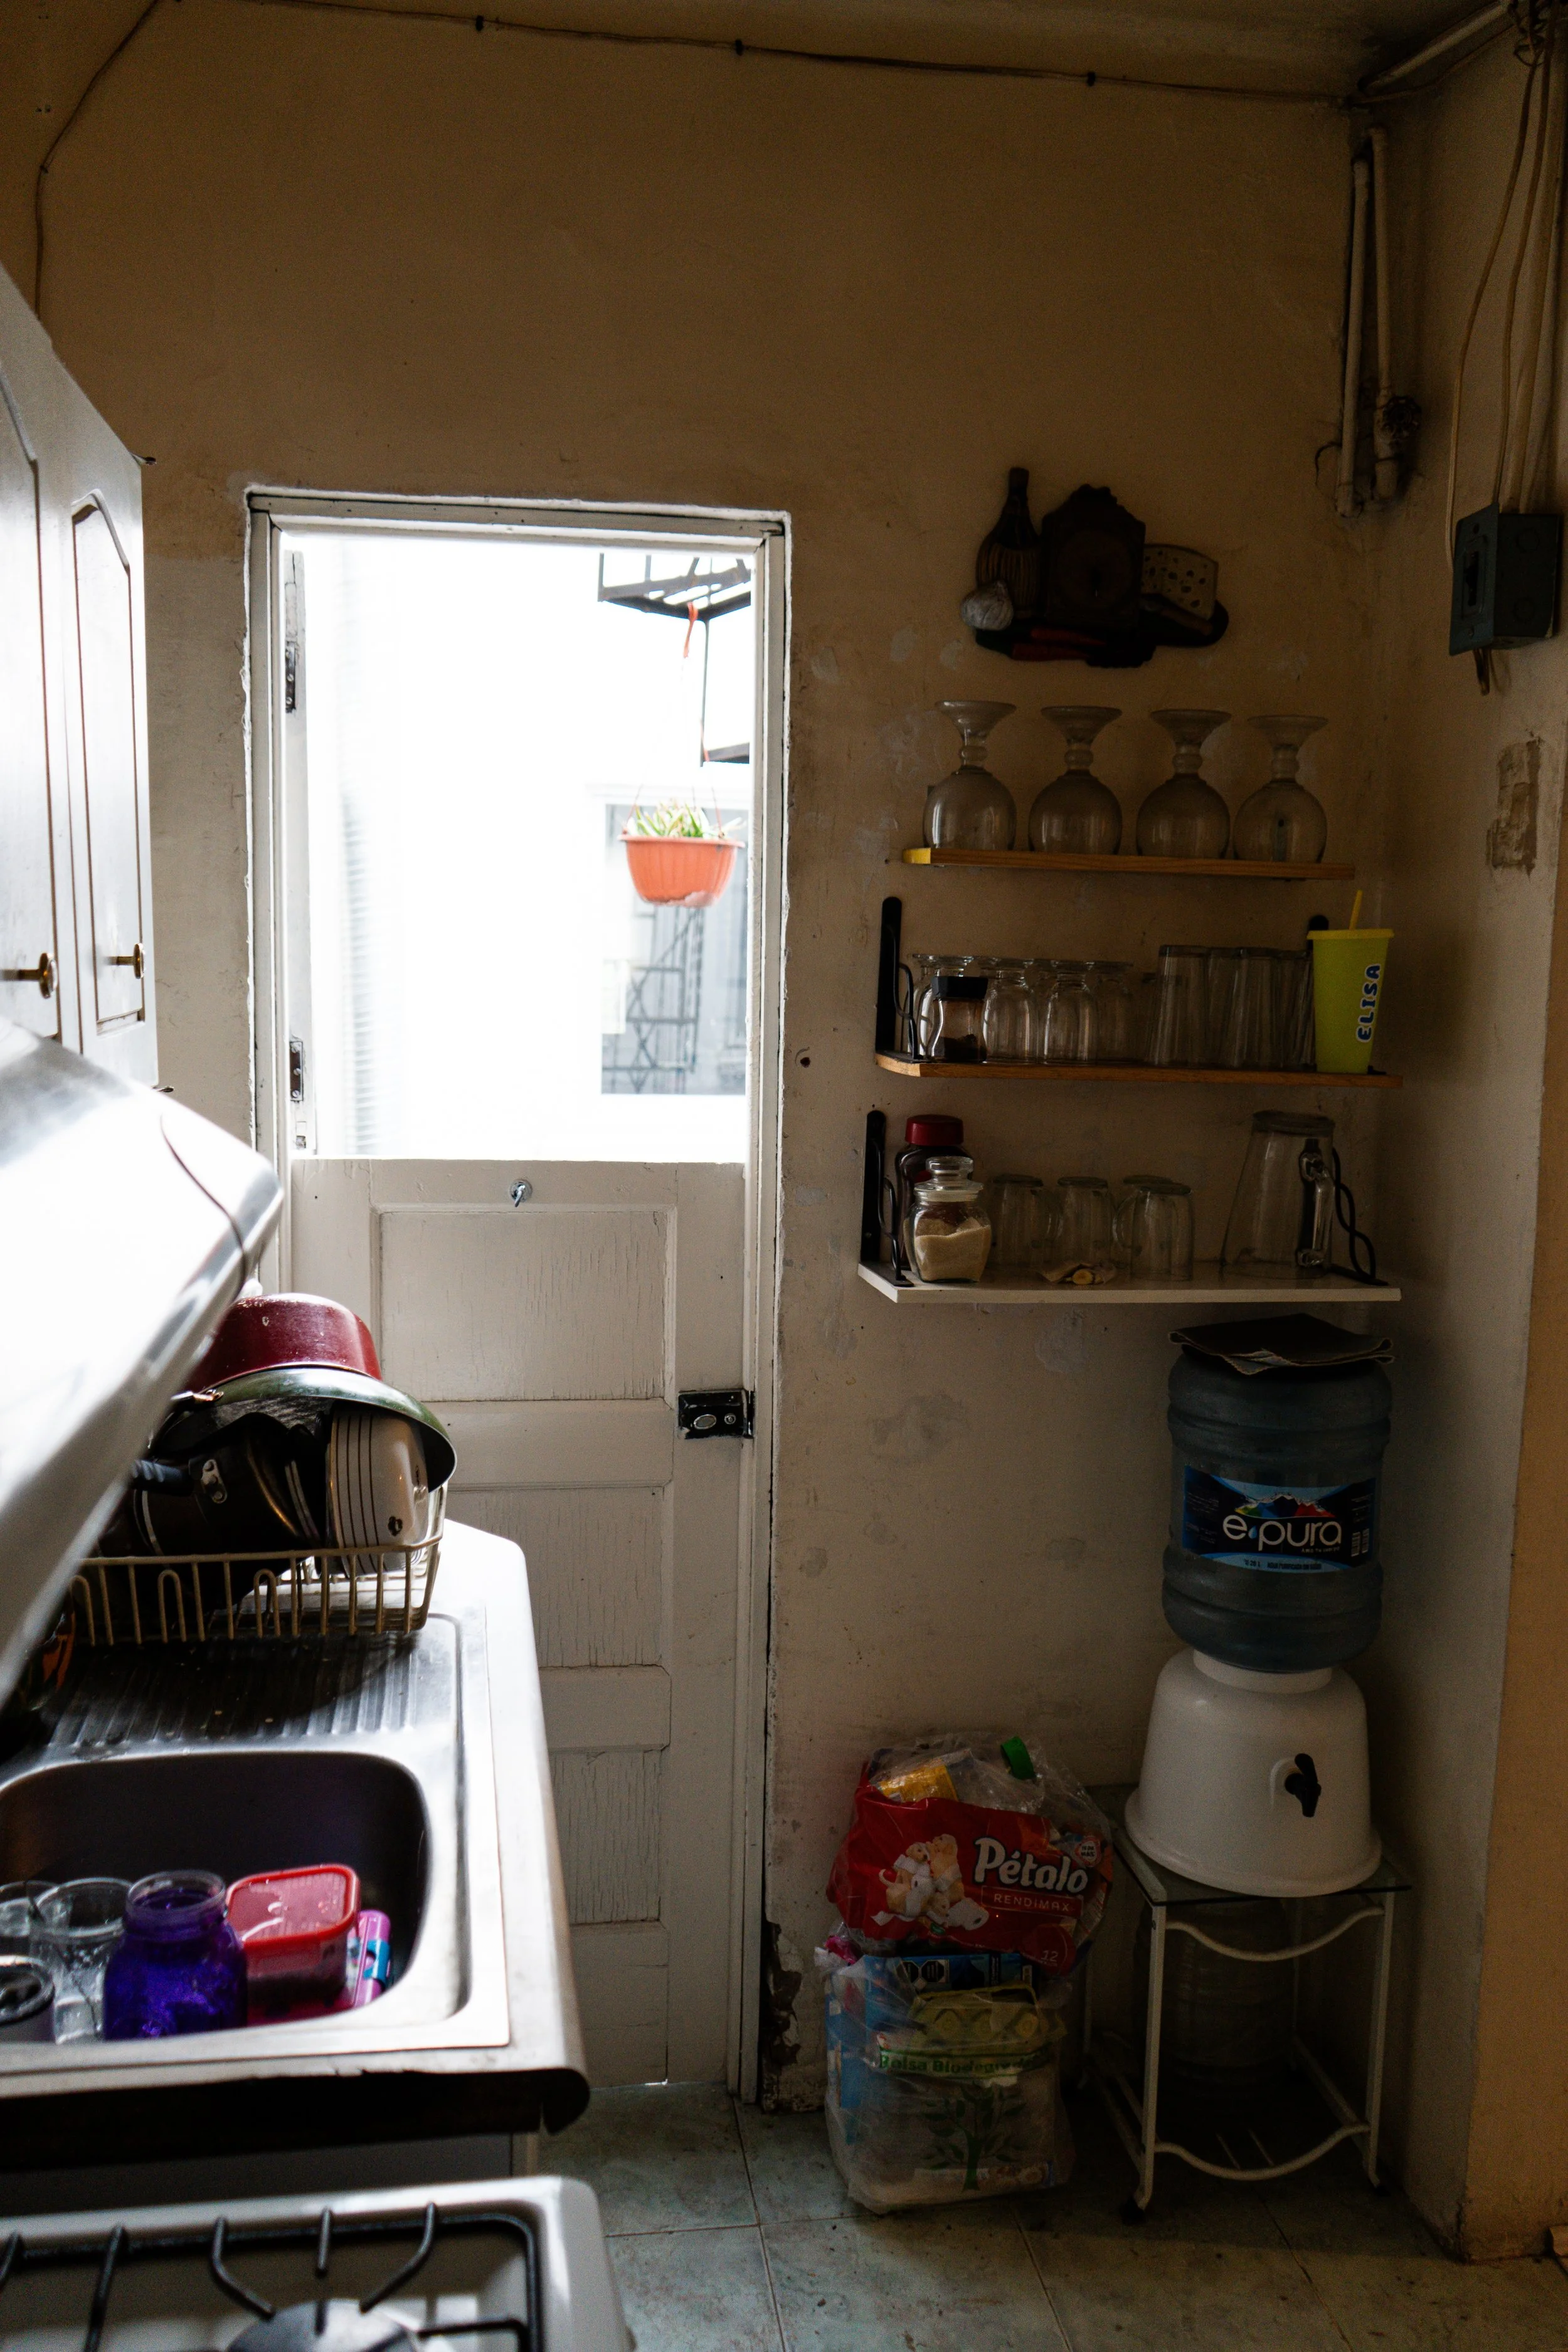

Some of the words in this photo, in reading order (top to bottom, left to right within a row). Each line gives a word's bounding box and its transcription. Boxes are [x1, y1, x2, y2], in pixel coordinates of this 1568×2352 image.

[1357, 963, 1381, 1042] ELISA
[973, 1836, 1089, 1894] Pétalo
[993, 1894, 1071, 1912] RENDIMAX
[1041, 1950, 1059, 1962] 12
[880, 2054, 927, 2071] Bolsa
